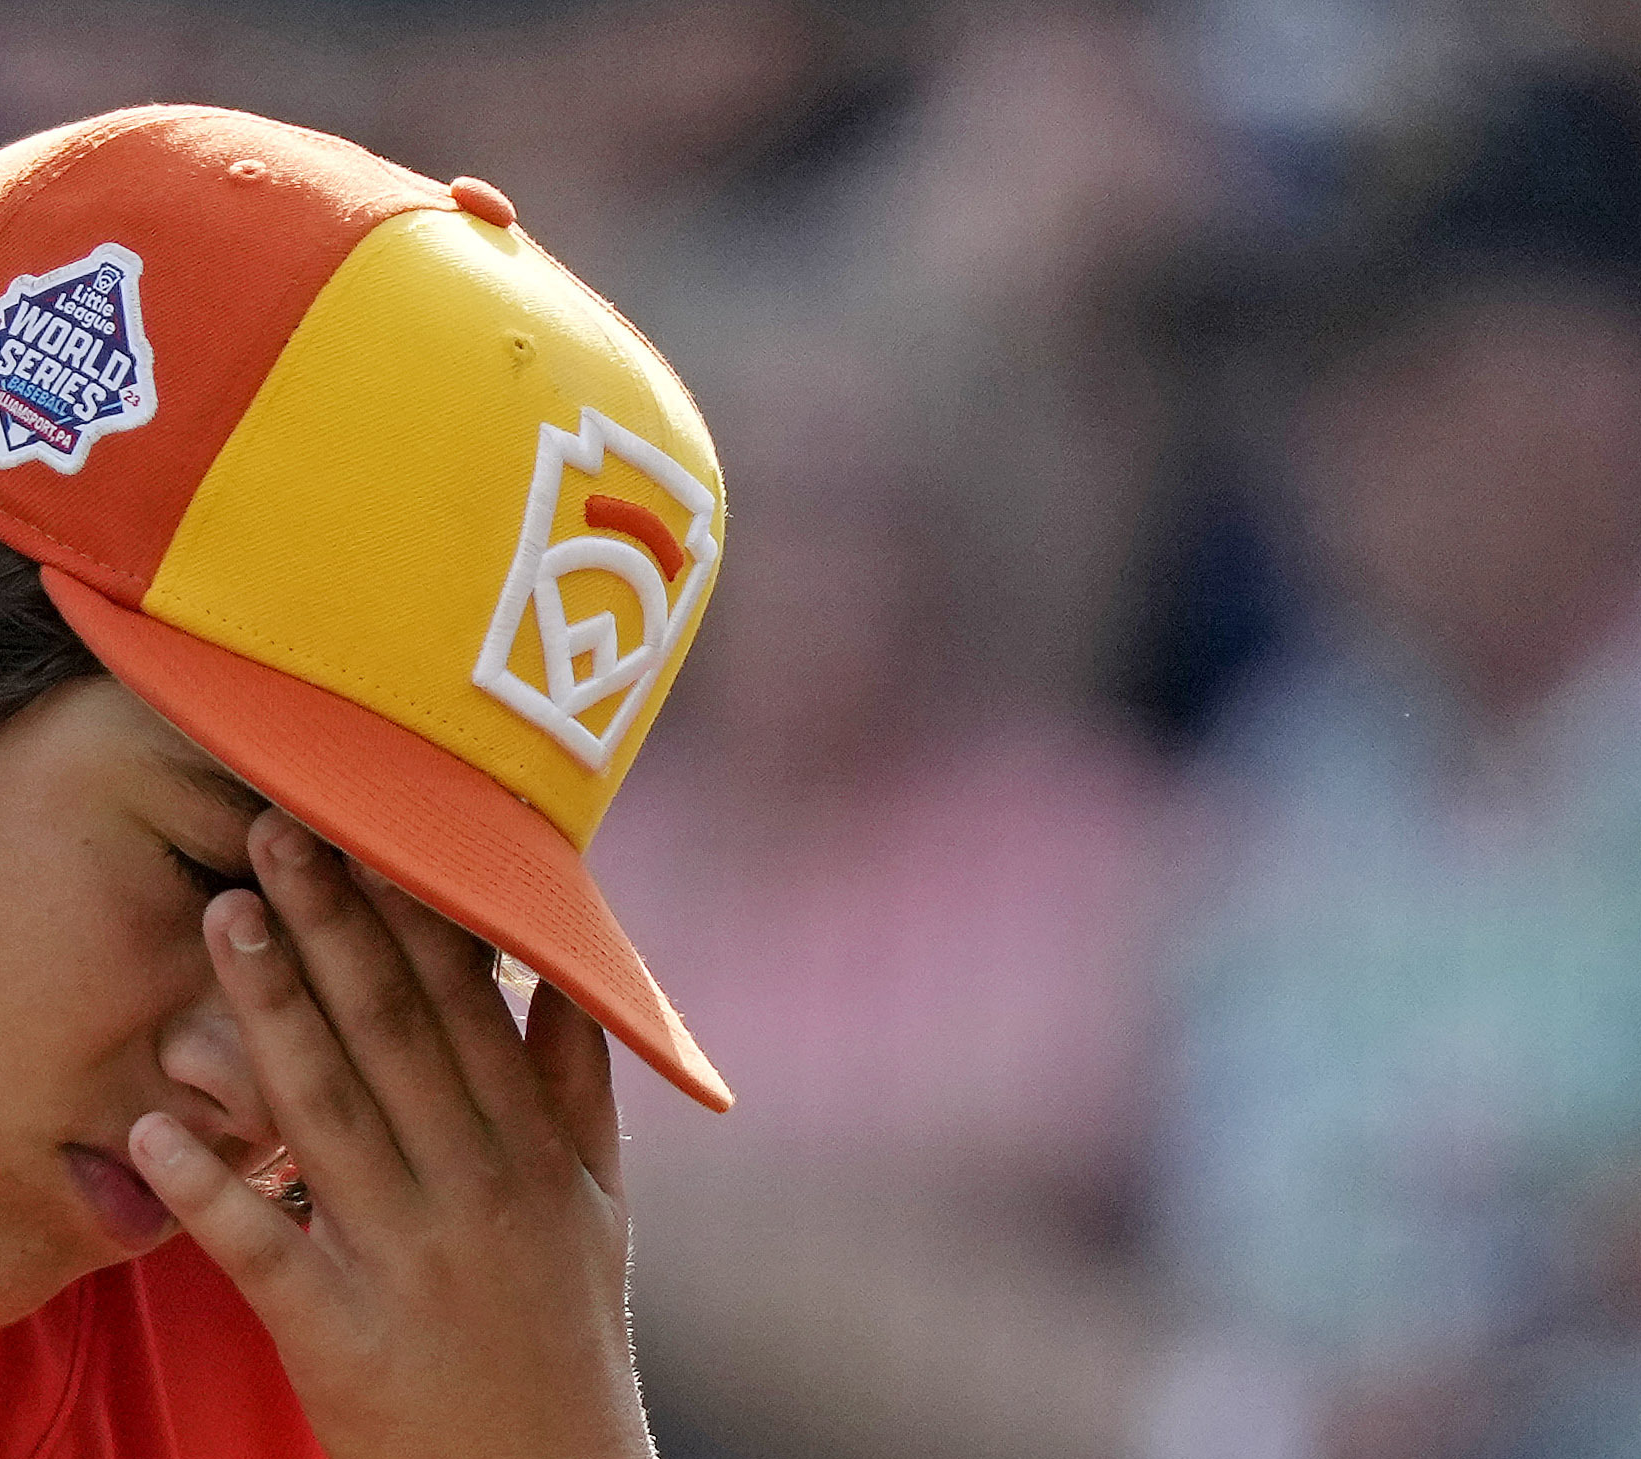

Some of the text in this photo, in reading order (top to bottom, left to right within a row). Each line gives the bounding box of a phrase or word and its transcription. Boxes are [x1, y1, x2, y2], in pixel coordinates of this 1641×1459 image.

[56, 294, 116, 335] League
[72, 284, 114, 317] Little
[8, 300, 132, 391] WORLD
[7, 376, 68, 416] BASEBALL
